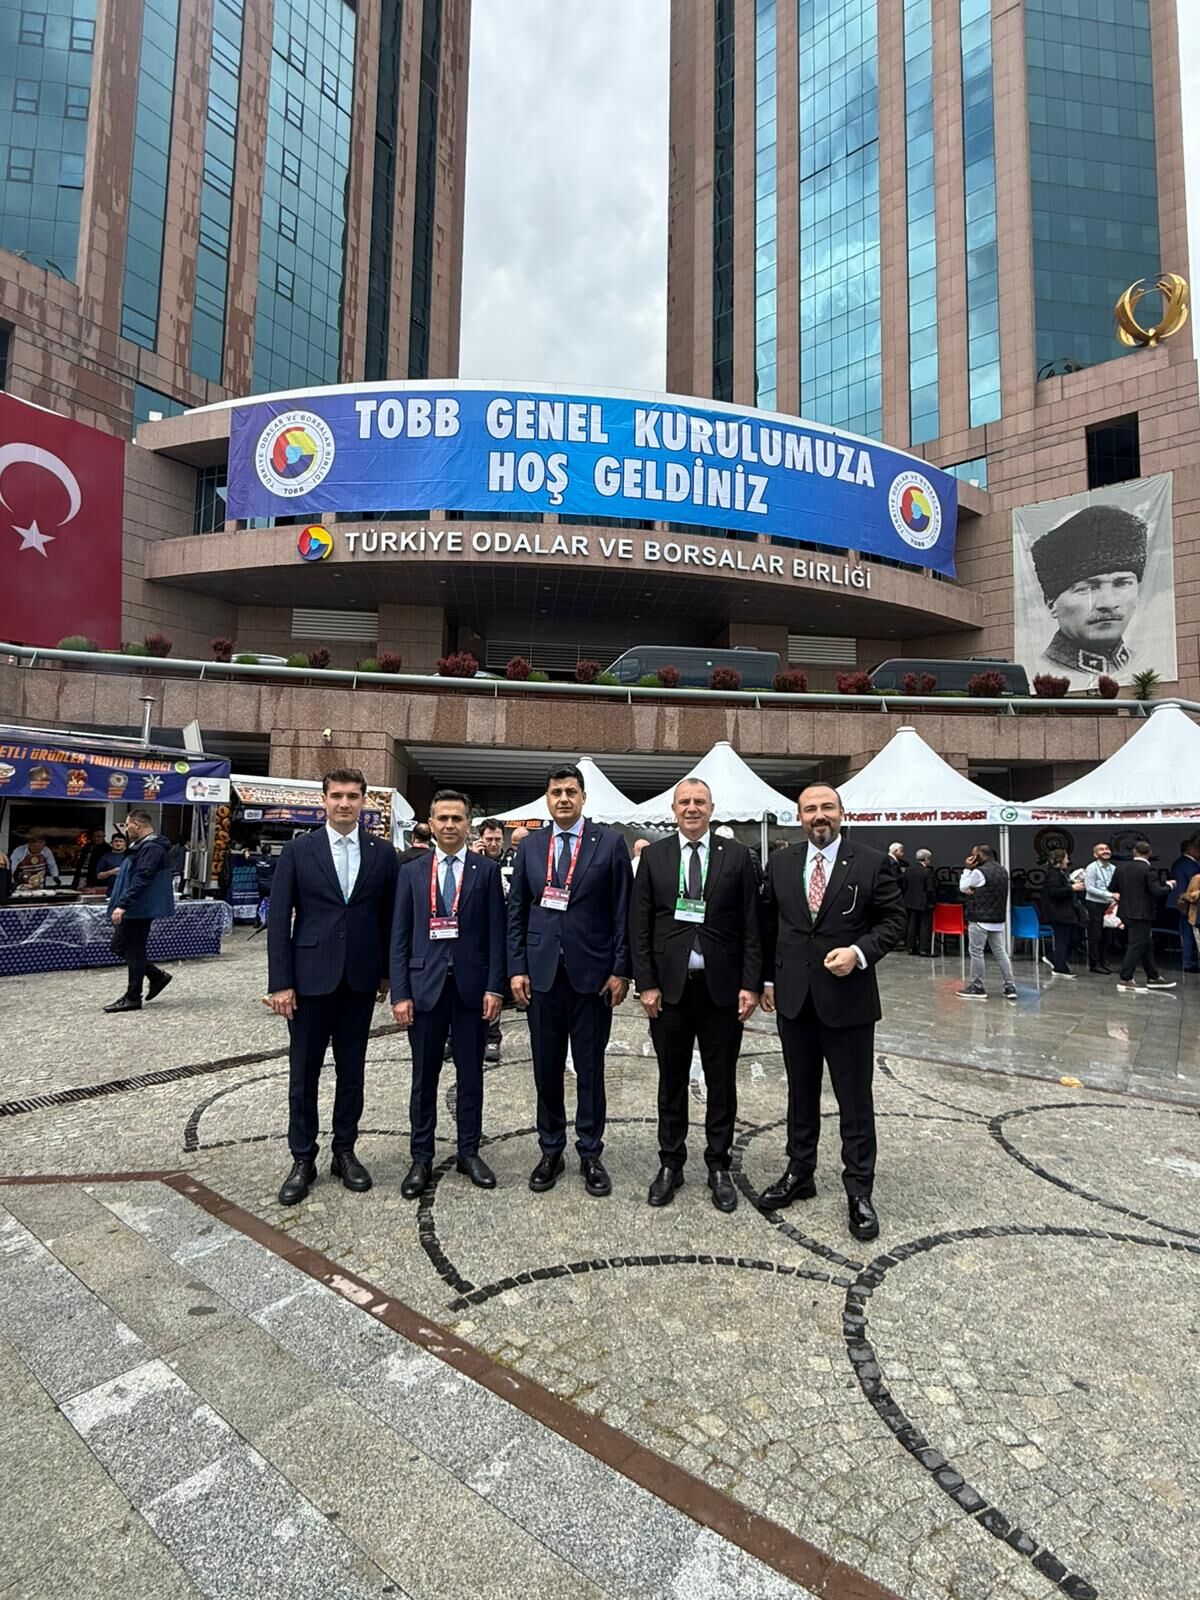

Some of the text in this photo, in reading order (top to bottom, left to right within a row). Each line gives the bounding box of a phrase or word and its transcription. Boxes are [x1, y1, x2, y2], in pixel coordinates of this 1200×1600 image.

[354, 398, 877, 489] TOBB GENEL KURULUMUZA
[487, 450, 770, 515] HOŞ GELDİNİZ
[344, 528, 463, 553] TÜRKİYE
[471, 532, 590, 557] ODALAR
[598, 538, 634, 559] VE
[643, 540, 785, 575] BORSALAR
[29, 748, 86, 765] ÜRÜNLER
[137, 760, 173, 773] ARACI
[884, 813, 898, 822] VE
